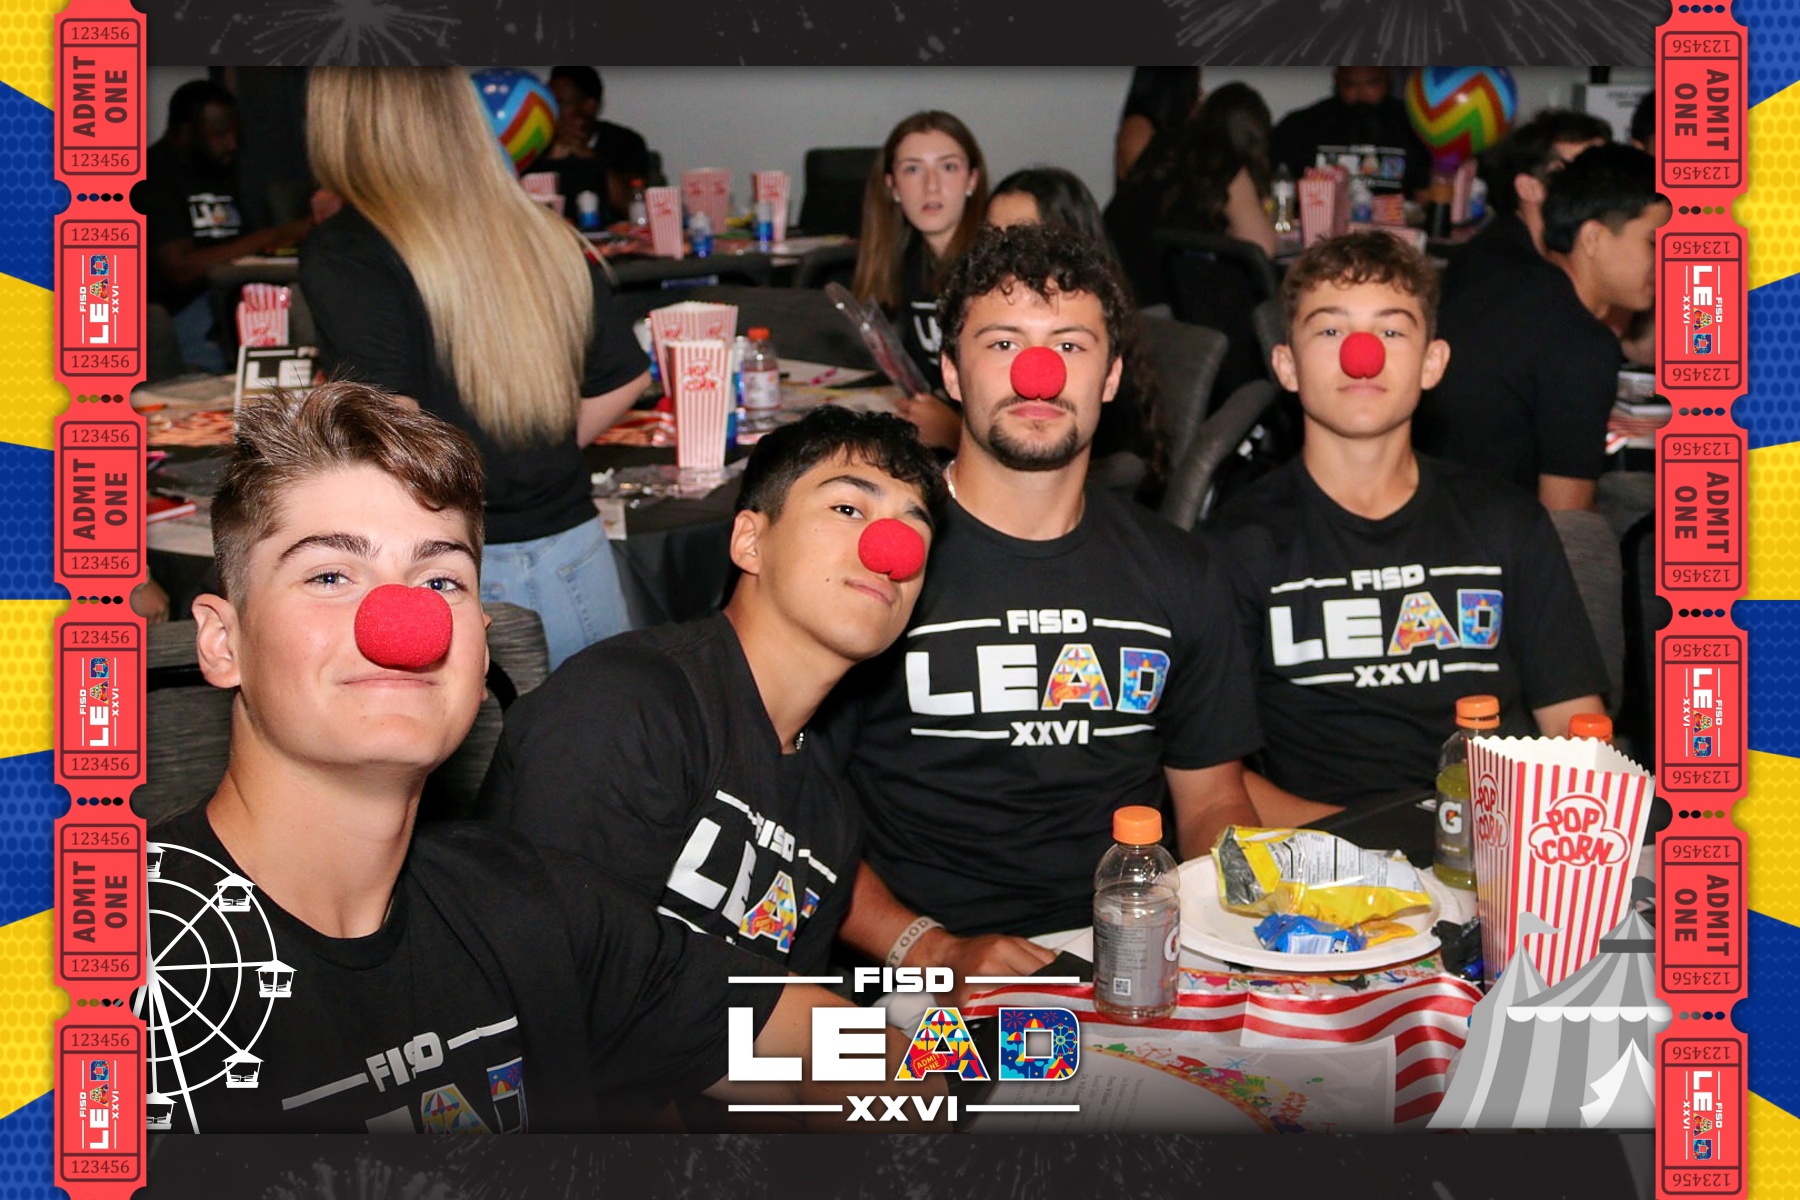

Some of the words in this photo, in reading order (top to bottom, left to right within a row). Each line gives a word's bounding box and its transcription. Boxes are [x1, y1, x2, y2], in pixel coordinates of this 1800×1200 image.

[1351, 564, 1426, 591] FISD
[1007, 609, 1087, 635] FISD
[1269, 588, 1503, 667] LEAD
[905, 643, 1172, 716] LEAD
[1353, 659, 1440, 688] XXVI
[1010, 720, 1089, 746] XXVI
[1475, 786, 1497, 813] POP
[1438, 801, 1462, 834] G
[1477, 814, 1504, 847] CORN
[1547, 806, 1600, 833] POP
[1541, 836, 1616, 867] CORN
